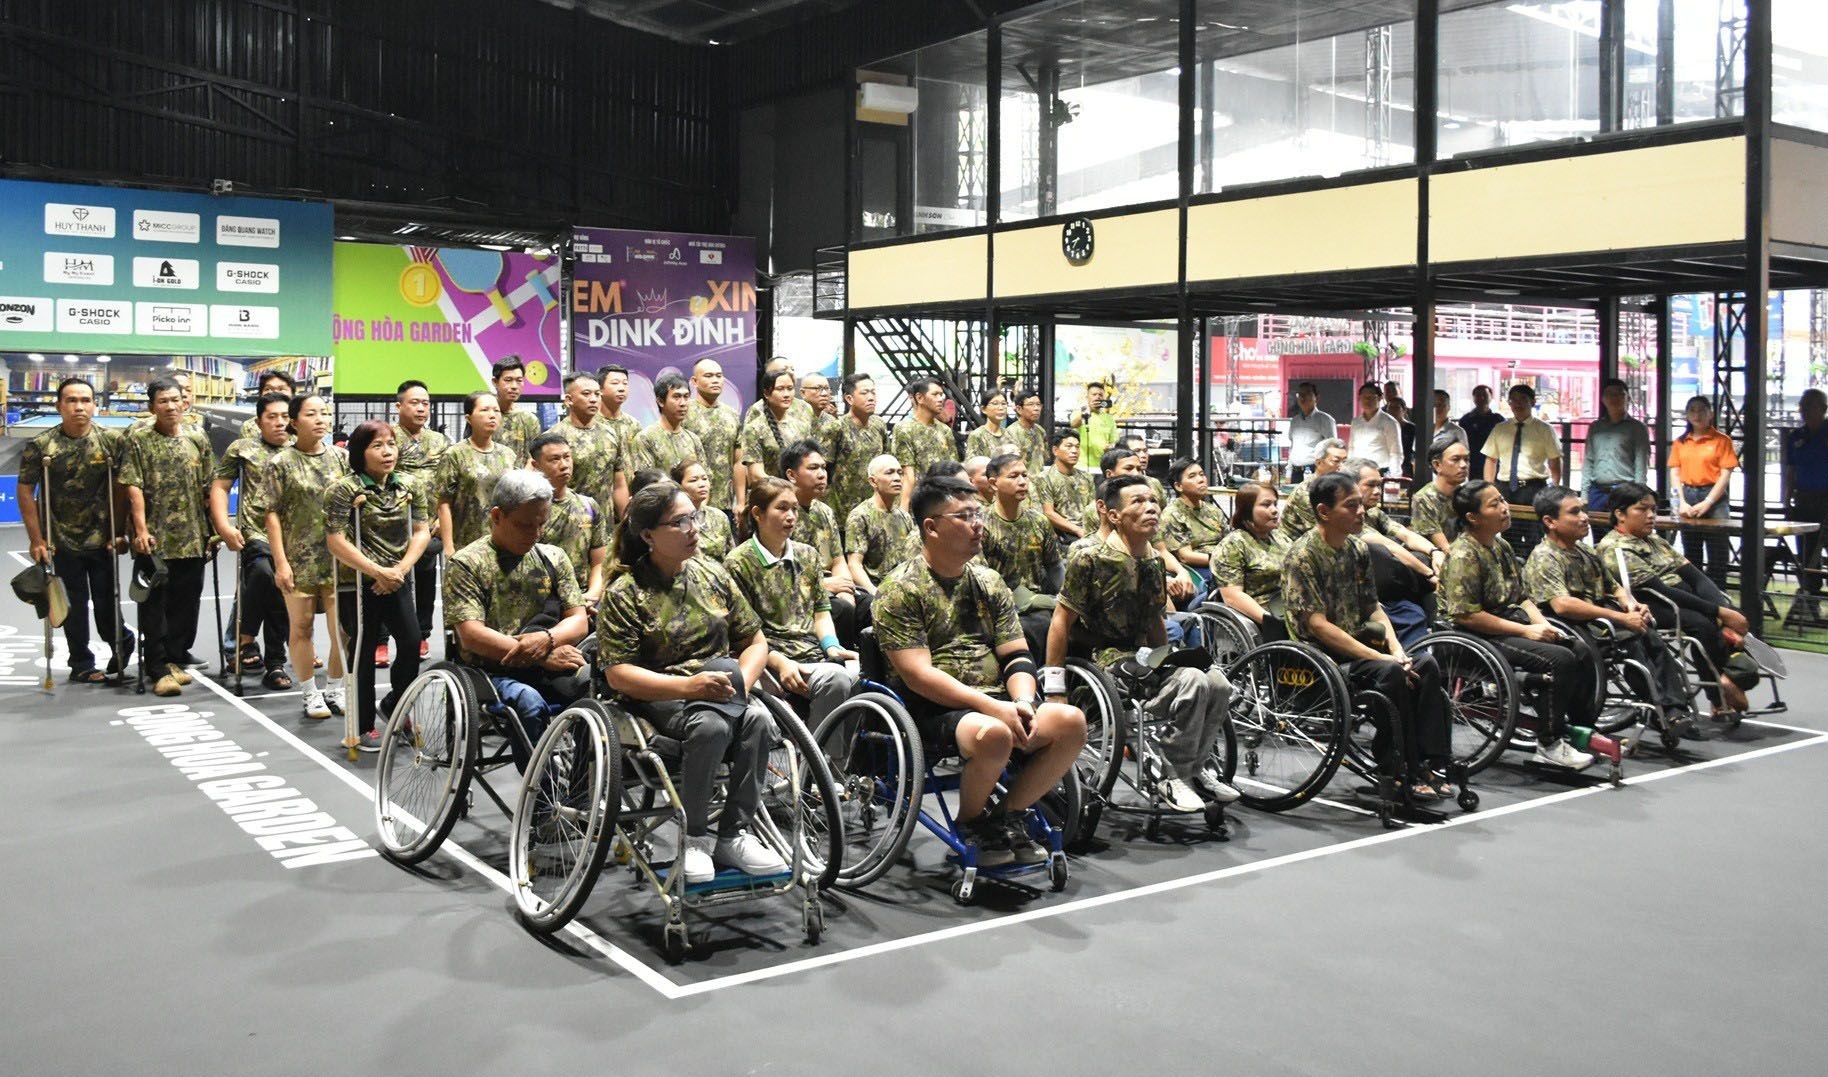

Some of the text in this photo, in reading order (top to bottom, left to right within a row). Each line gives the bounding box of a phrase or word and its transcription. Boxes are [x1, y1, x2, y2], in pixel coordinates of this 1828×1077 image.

[55, 221, 74, 230] HUY
[75, 222, 106, 232] THANH
[256, 227, 276, 235] WATCH
[226, 269, 270, 279] G-SHOCK
[68, 307, 121, 318] G-SHOCK
[152, 315, 176, 323] Picko
[371, 315, 404, 342] HÒA
[409, 321, 472, 343] GARDEN
[588, 318, 666, 348] DINK
[110, 703, 380, 869] CỘNG HÒA GARDEN
